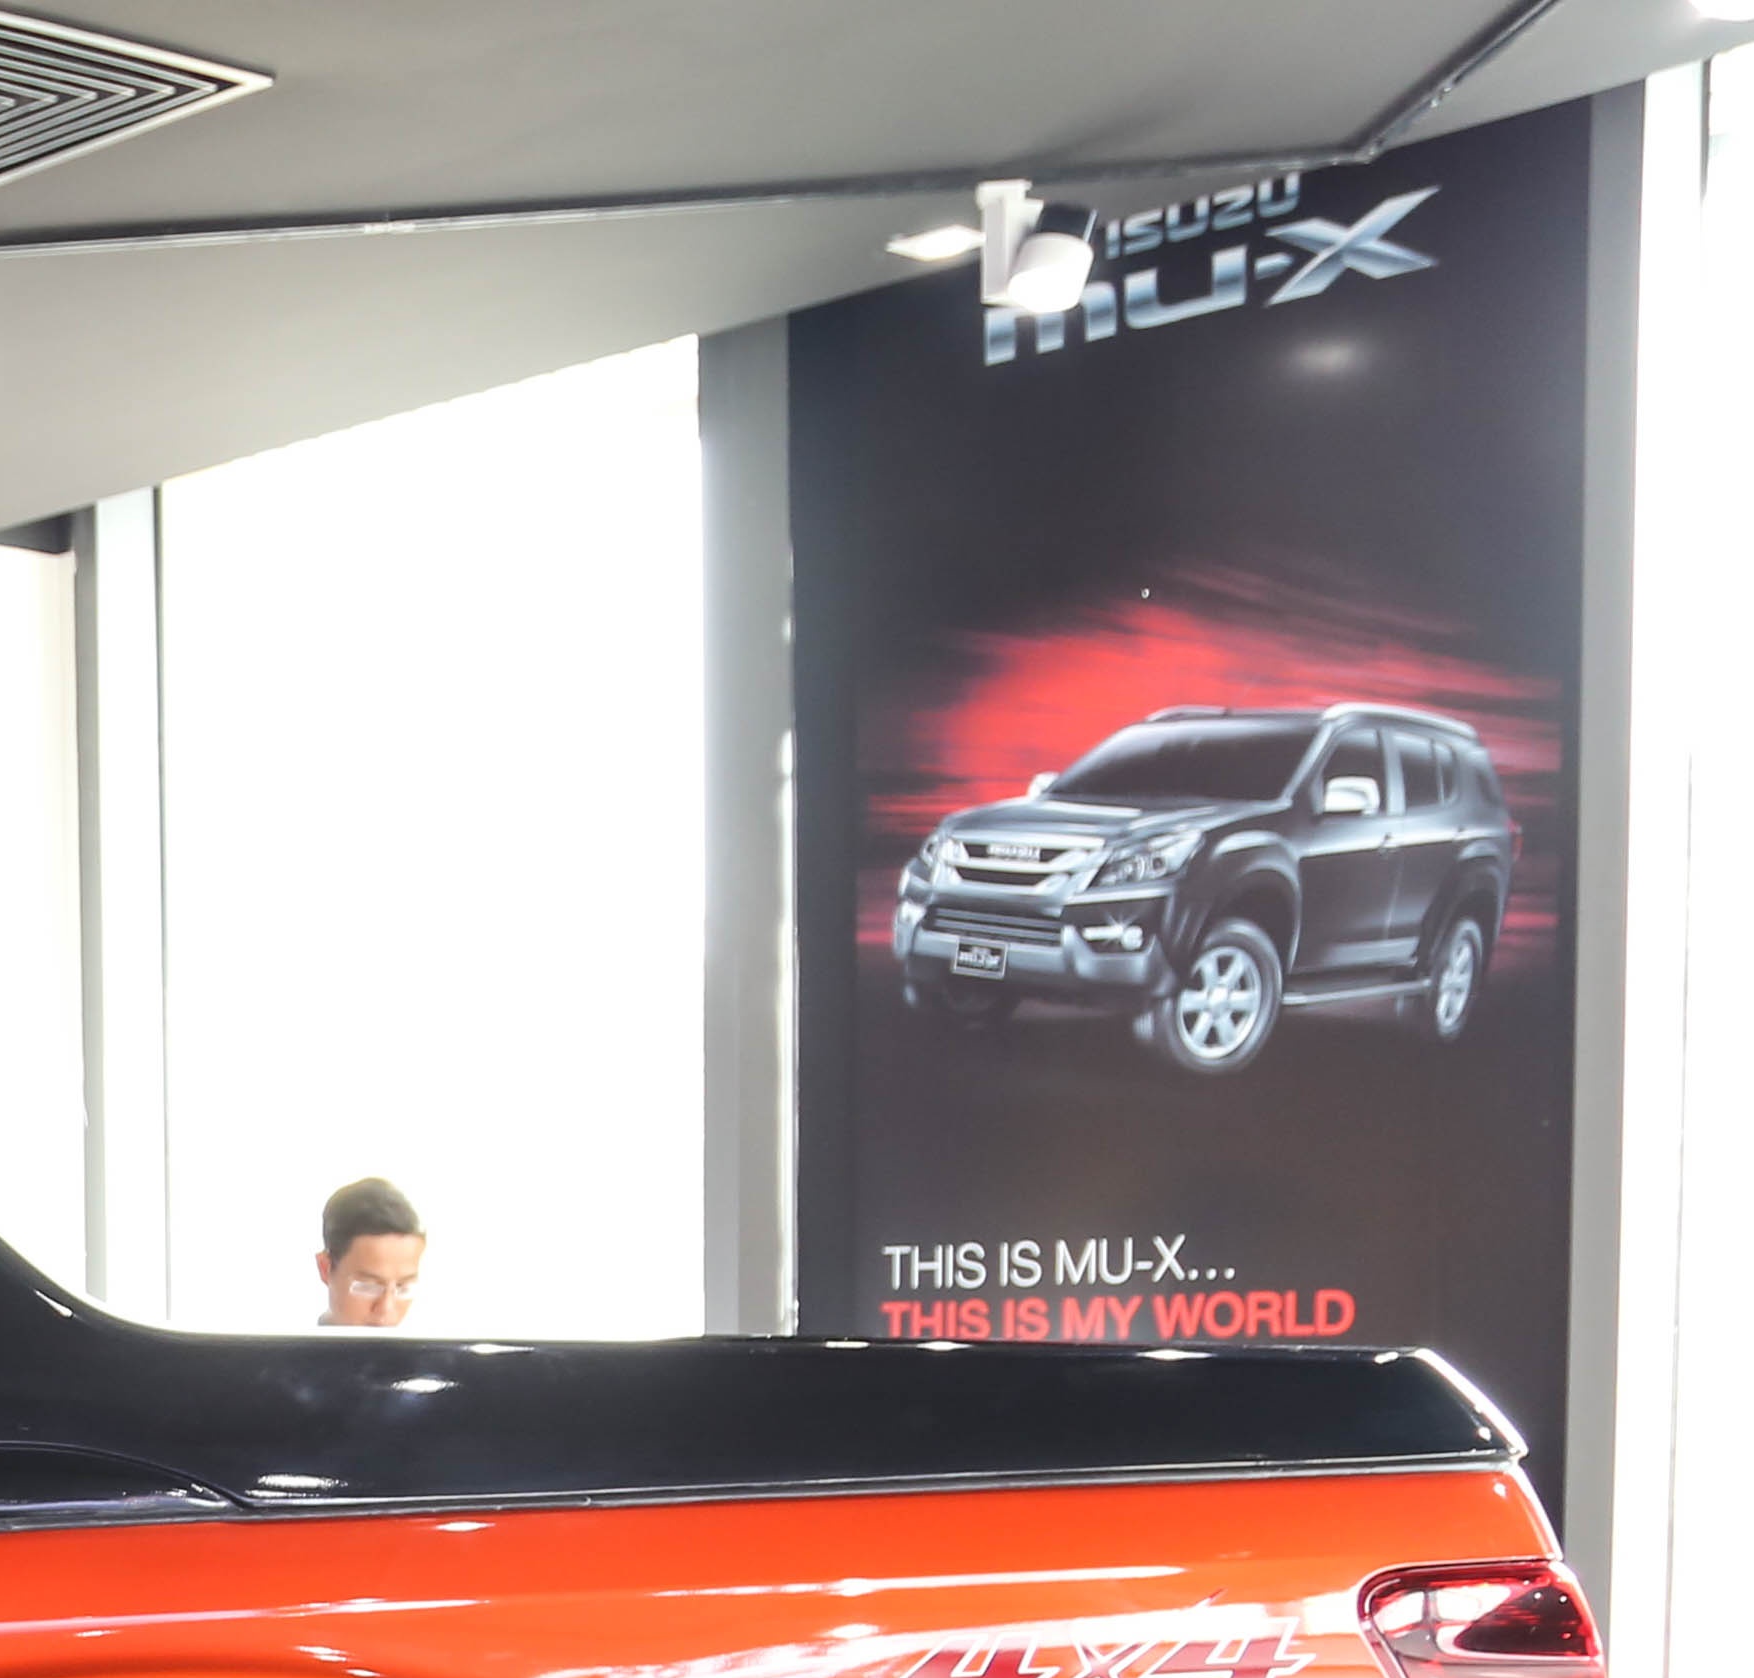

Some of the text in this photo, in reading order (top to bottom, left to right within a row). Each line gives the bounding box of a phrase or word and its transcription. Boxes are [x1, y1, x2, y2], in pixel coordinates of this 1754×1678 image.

[1104, 171, 1302, 261] ISUZU
[882, 1242, 987, 1290] THIS
[999, 1239, 1042, 1288] IS
[880, 1288, 1357, 1341] THIS IS MY WORLD
